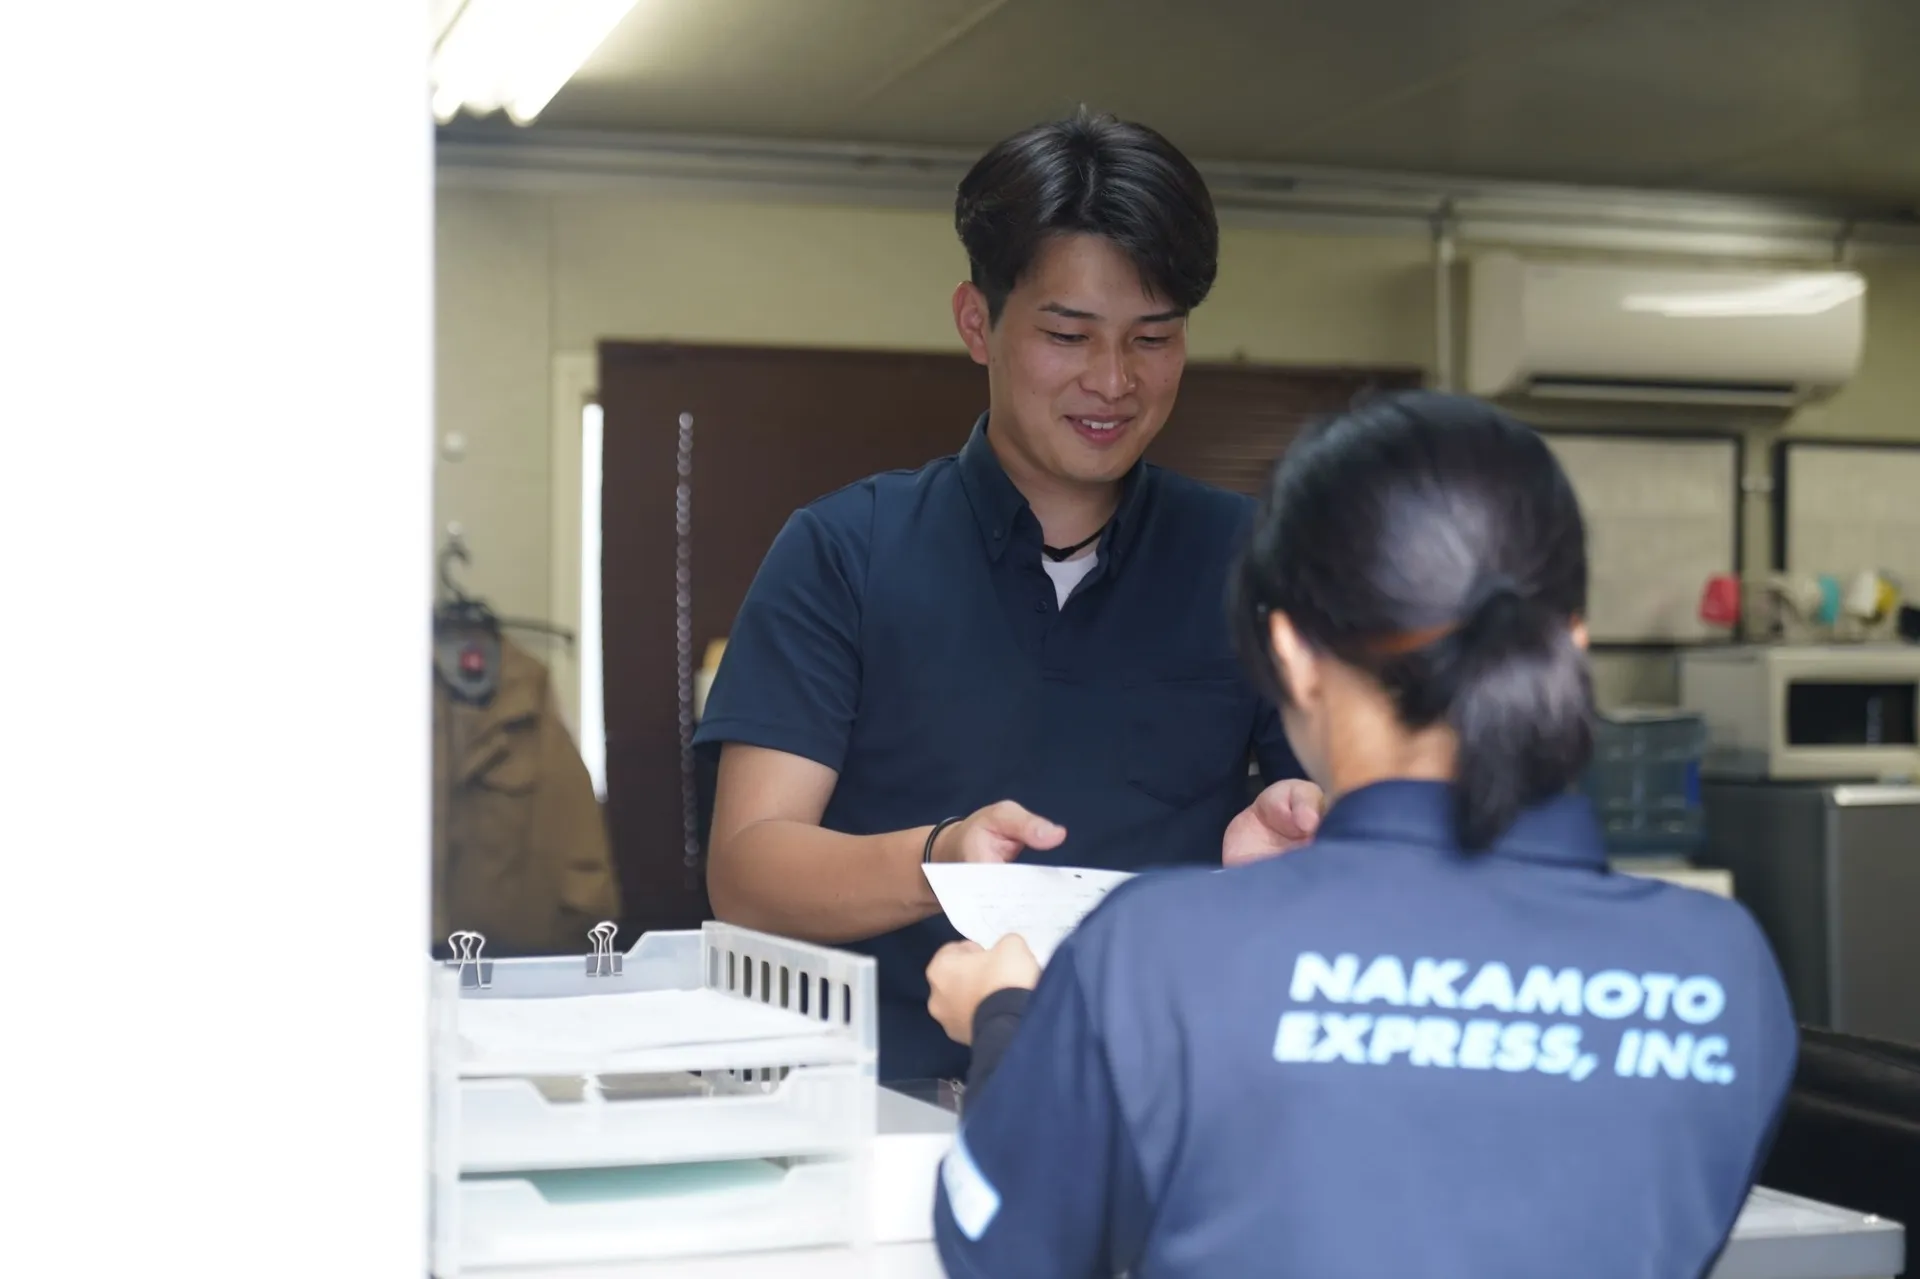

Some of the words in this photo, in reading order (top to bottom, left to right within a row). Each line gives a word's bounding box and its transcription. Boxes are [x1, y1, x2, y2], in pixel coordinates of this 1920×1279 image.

[1290, 951, 1726, 1024] NAKAMOTO
[1273, 1010, 1598, 1081] EXPRESS,
[1615, 1028, 1736, 1085] INC.
